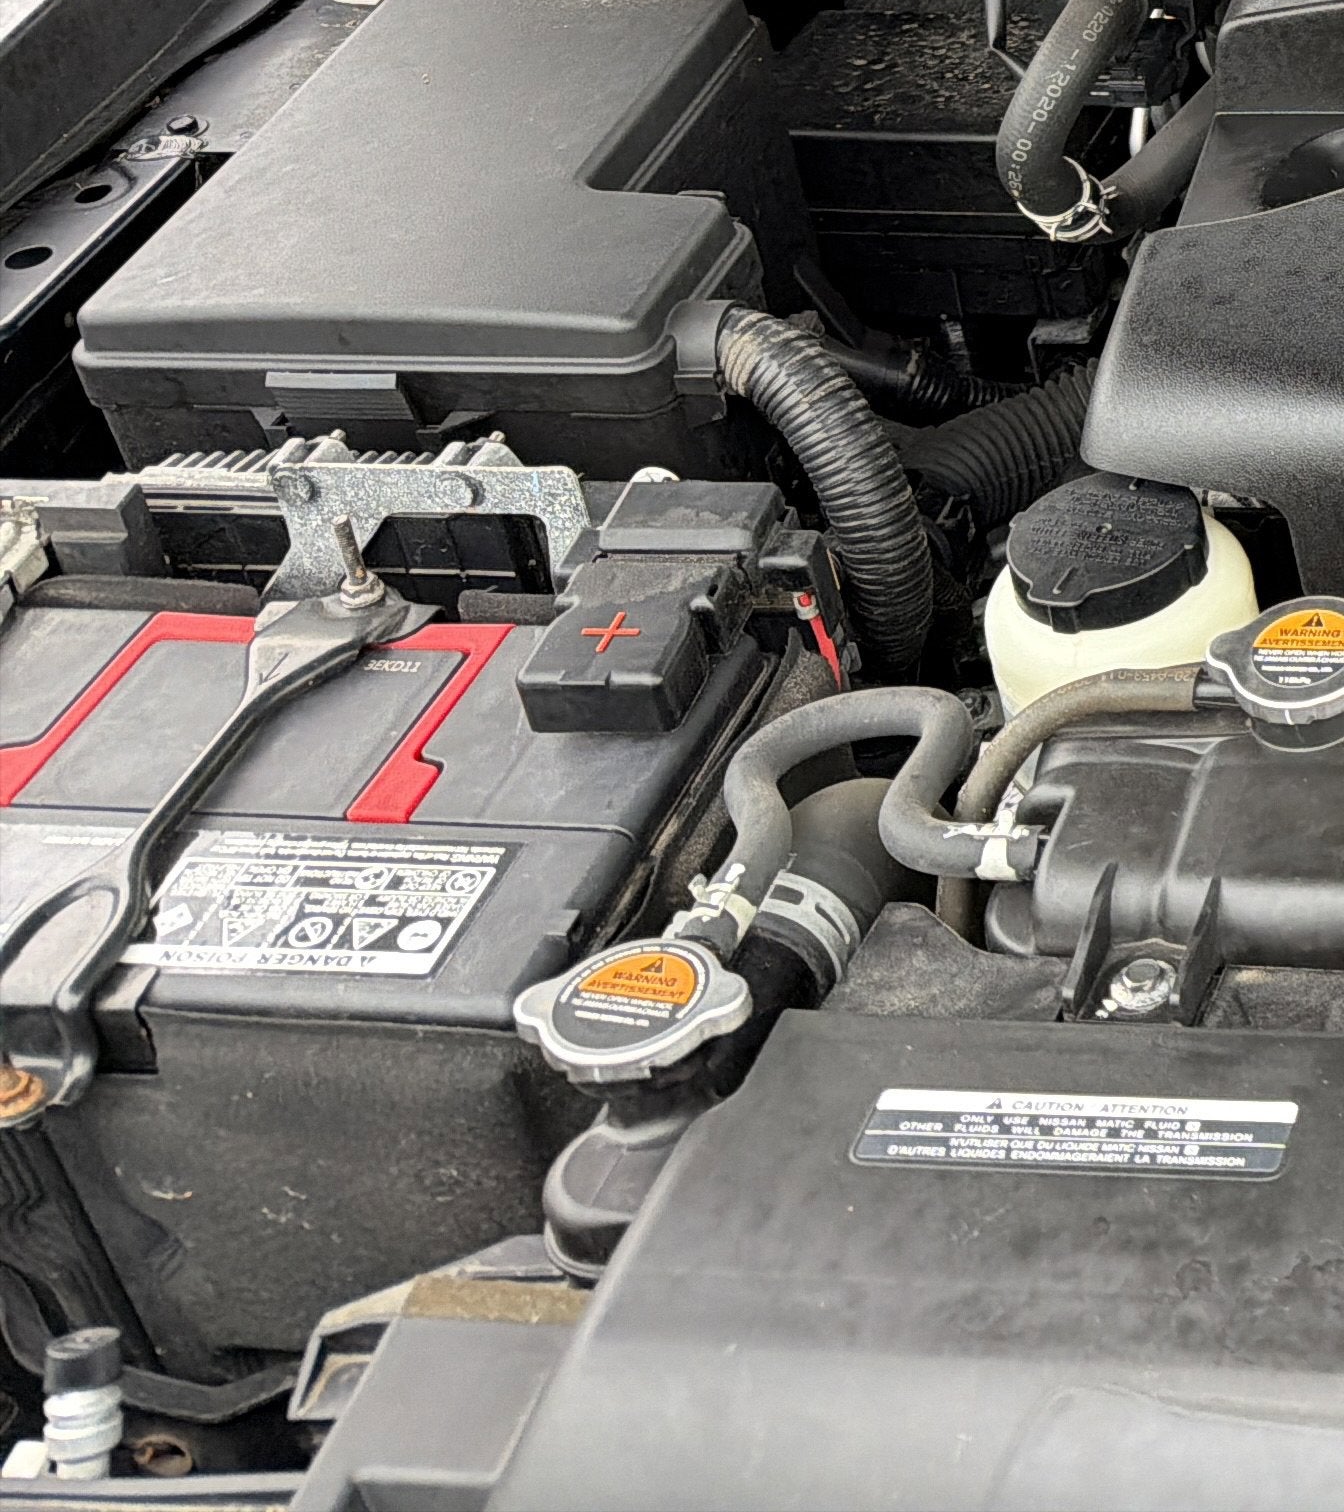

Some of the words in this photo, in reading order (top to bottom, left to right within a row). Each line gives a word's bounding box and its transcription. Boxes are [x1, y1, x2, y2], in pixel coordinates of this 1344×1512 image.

[1279, 628, 1341, 638] WARNING
[158, 949, 248, 964] POISON
[257, 953, 353, 967] DANGER
[612, 971, 678, 987] WARNING
[587, 979, 686, 999] AVERTISSEMENT
[1012, 1100, 1085, 1112] CAUTION
[1099, 1103, 1188, 1116] ATTENTION
[960, 1114, 995, 1124] ONLY
[1002, 1116, 1030, 1125] USE
[1038, 1117, 1087, 1127] NISSAN
[1143, 1120, 1180, 1130] FLUID
[898, 1120, 943, 1131] OTHER
[953, 1123, 999, 1134] FLUIDS
[1053, 1127, 1108, 1137] DAMAGE
[1120, 1129, 1145, 1139] THE
[1157, 1131, 1253, 1142] TRANSMISSION
[887, 1144, 946, 1157] D'AUTRES
[1134, 1154, 1150, 1164] LA
[1156, 1155, 1245, 1167] TRANSMISSION
